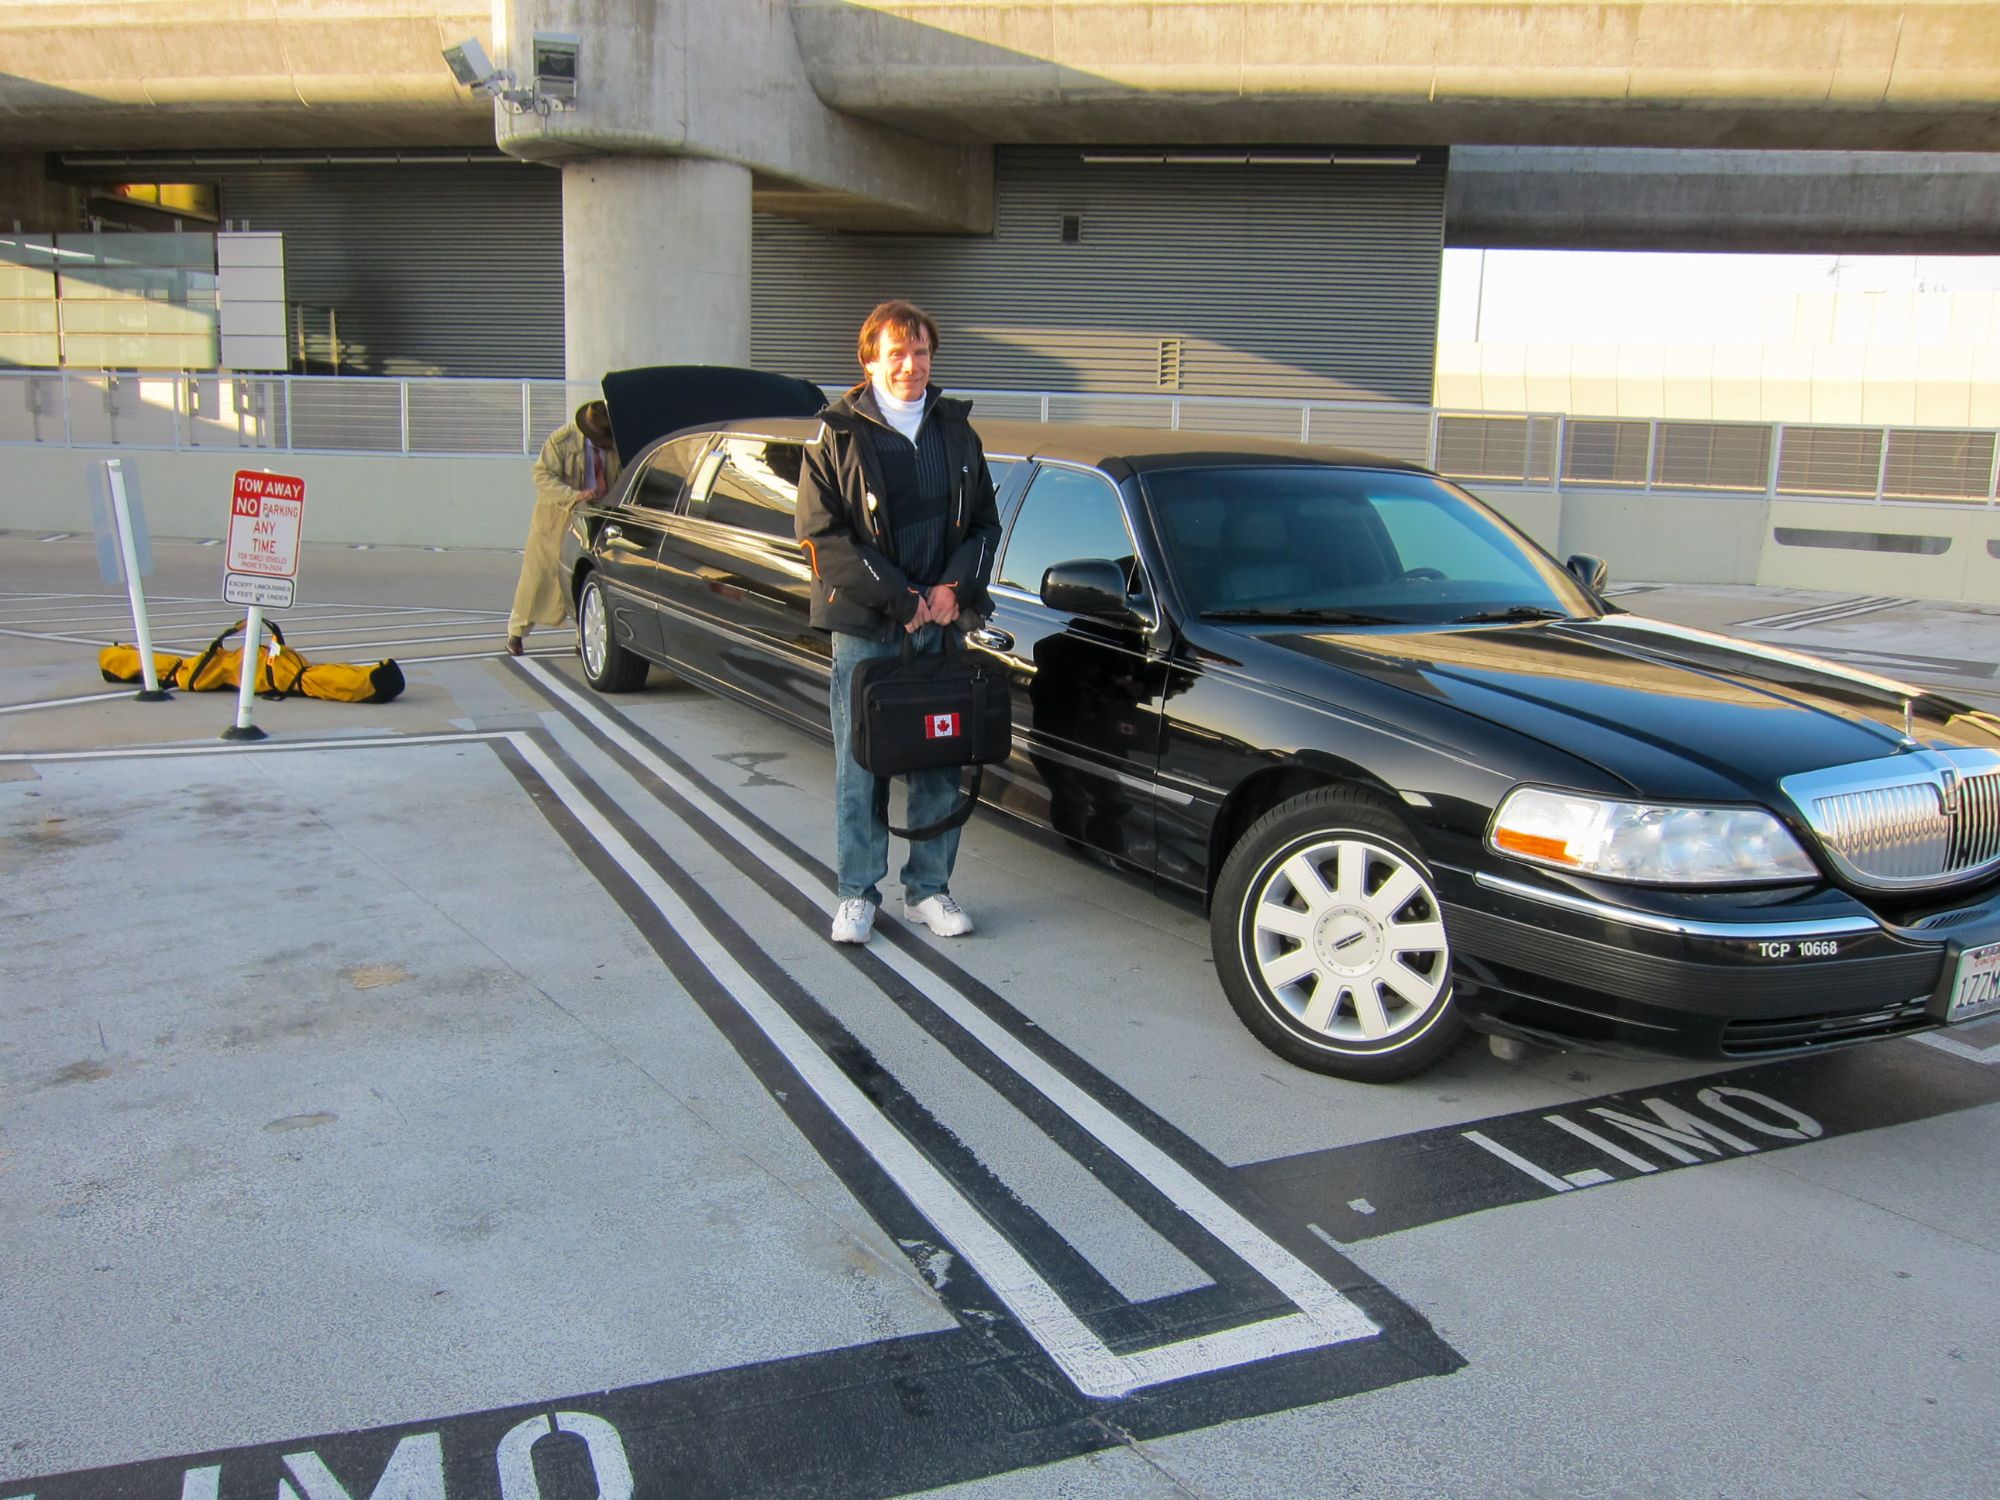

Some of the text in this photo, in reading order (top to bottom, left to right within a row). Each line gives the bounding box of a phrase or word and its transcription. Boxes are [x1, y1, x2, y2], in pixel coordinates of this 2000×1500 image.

[238, 477, 302, 498] TOW AWAY
[236, 497, 298, 518] NO PARKING
[253, 520, 276, 536] ANY
[252, 538, 276, 554] TIME
[254, 583, 291, 592] LIMOUSINES
[1758, 940, 1838, 958] TCP 10668
[1460, 1085, 1824, 1192] LIMO
